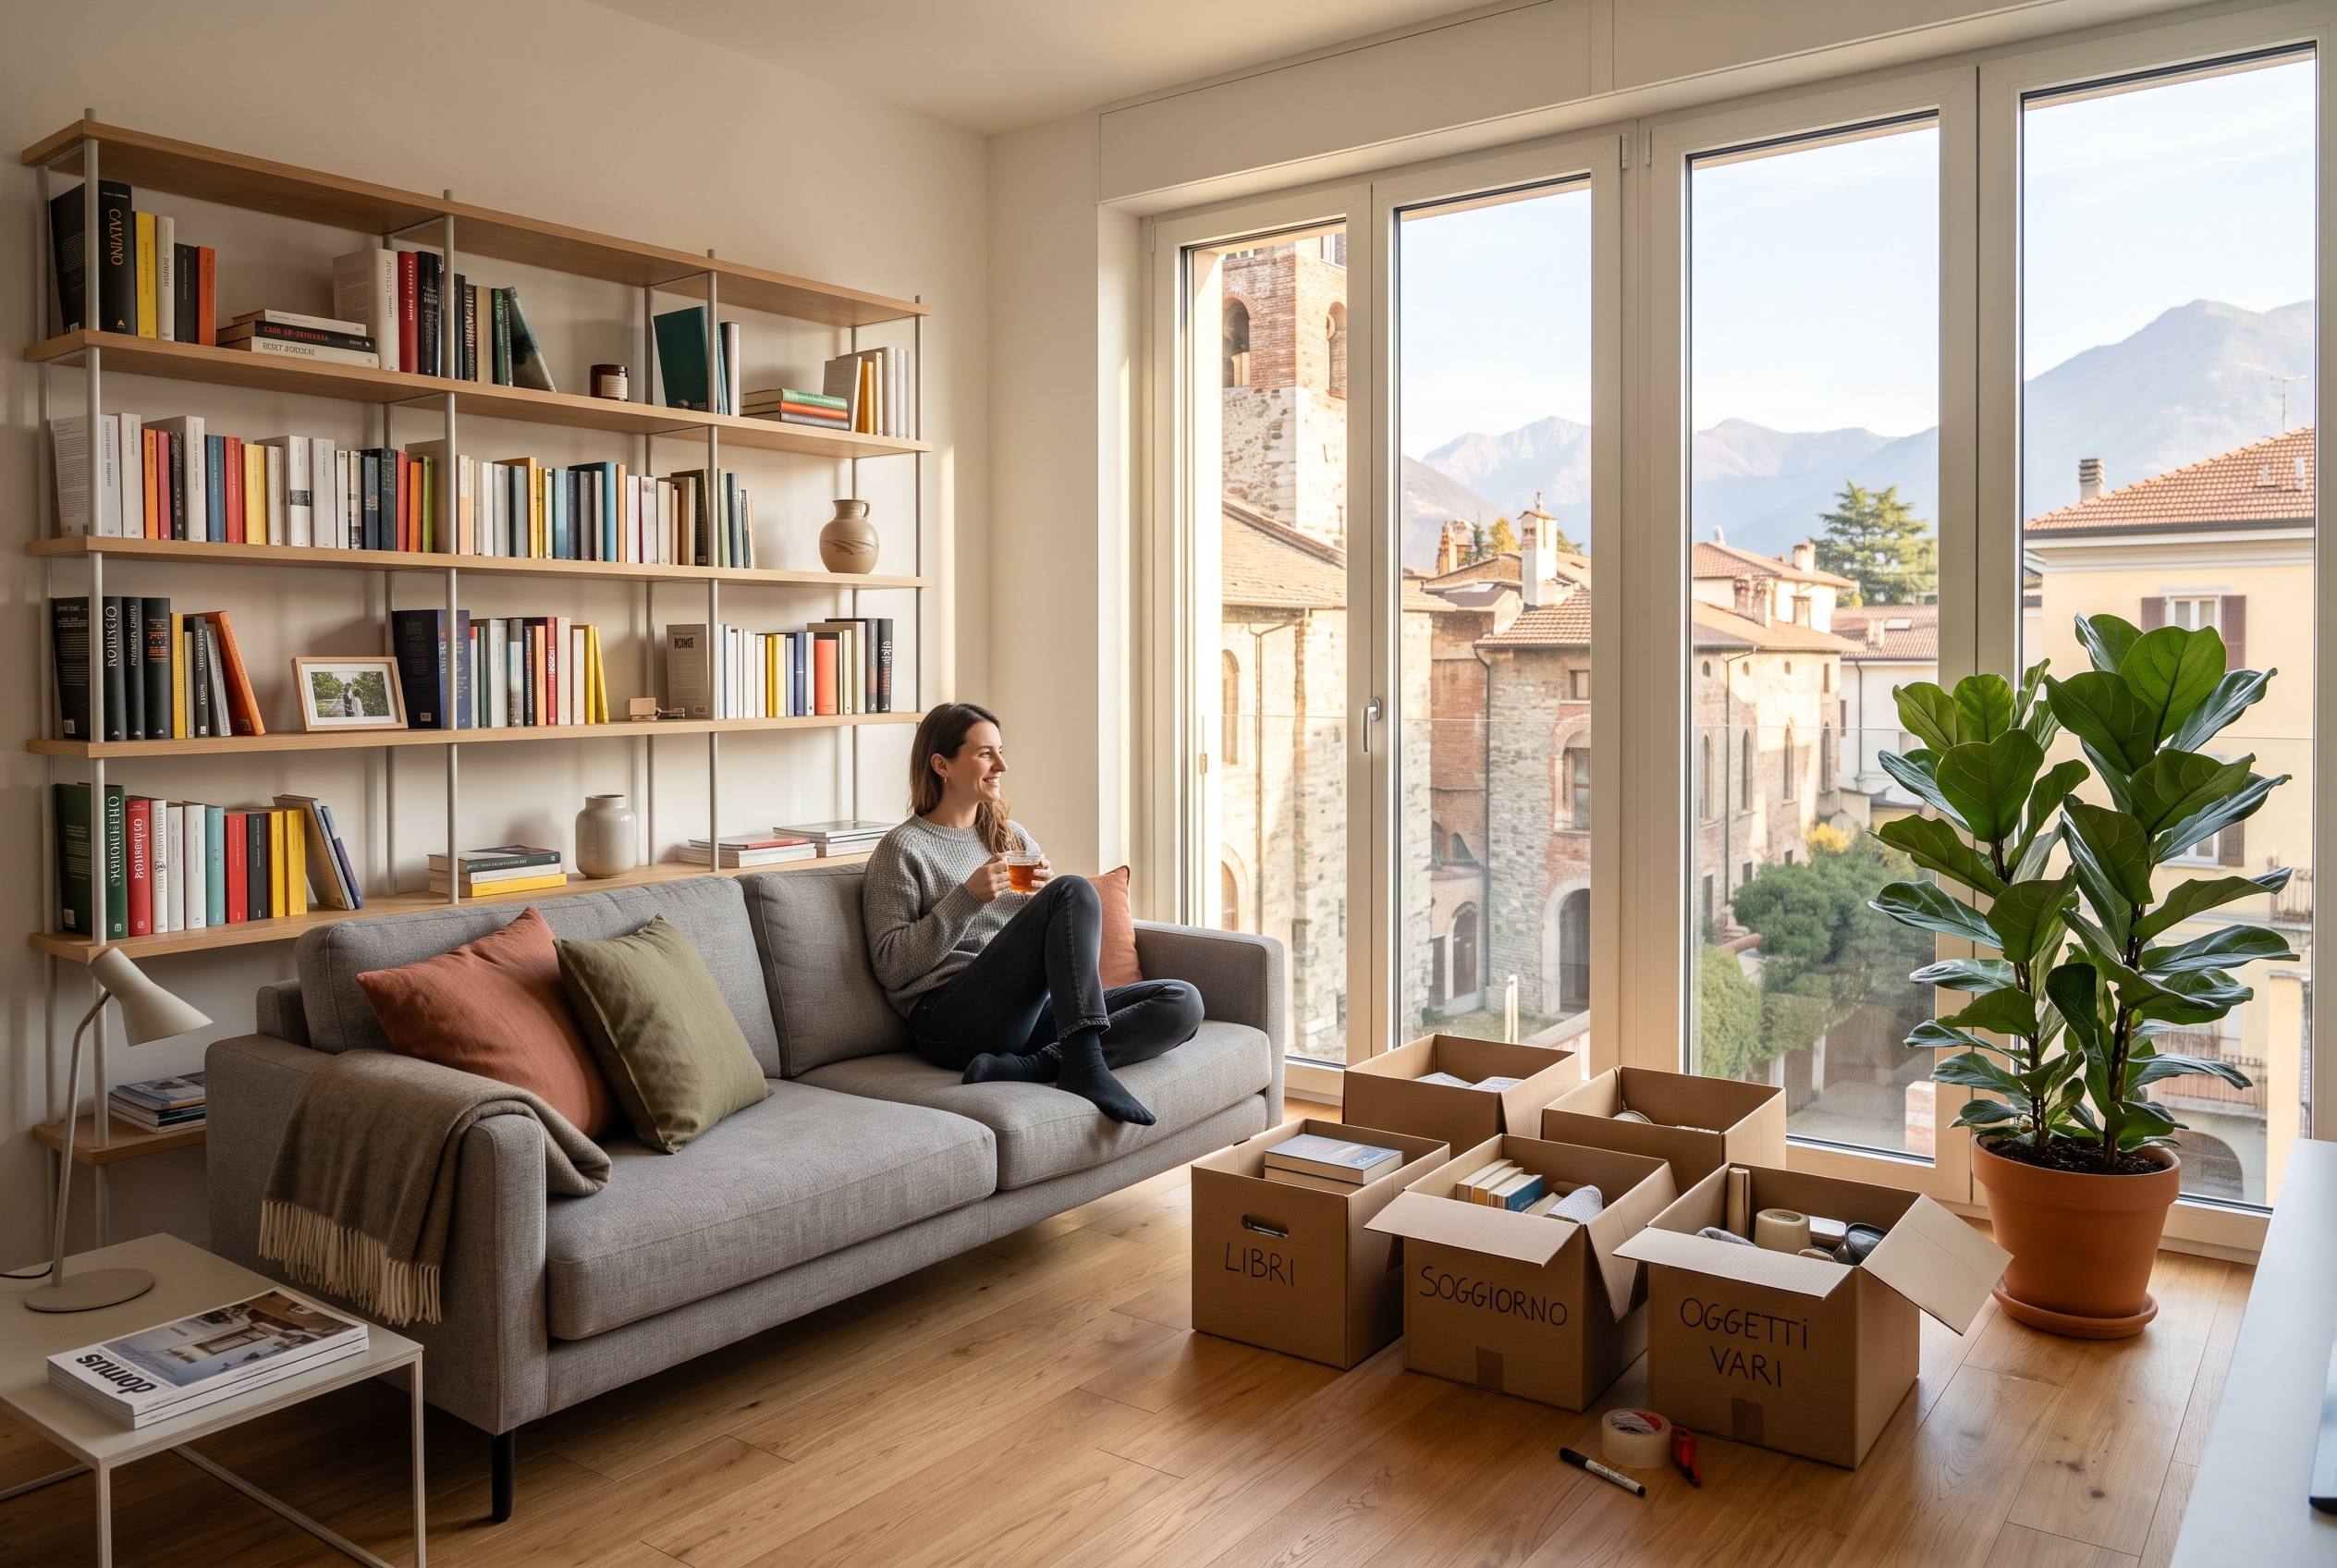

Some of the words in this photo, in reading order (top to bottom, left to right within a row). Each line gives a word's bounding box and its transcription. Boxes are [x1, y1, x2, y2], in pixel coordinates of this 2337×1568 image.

[108, 208, 123, 266] CALVINO
[1224, 1242, 1295, 1288] LIBRI
[76, 1354, 158, 1394] domus
[1708, 1345, 1783, 1390] VARI
